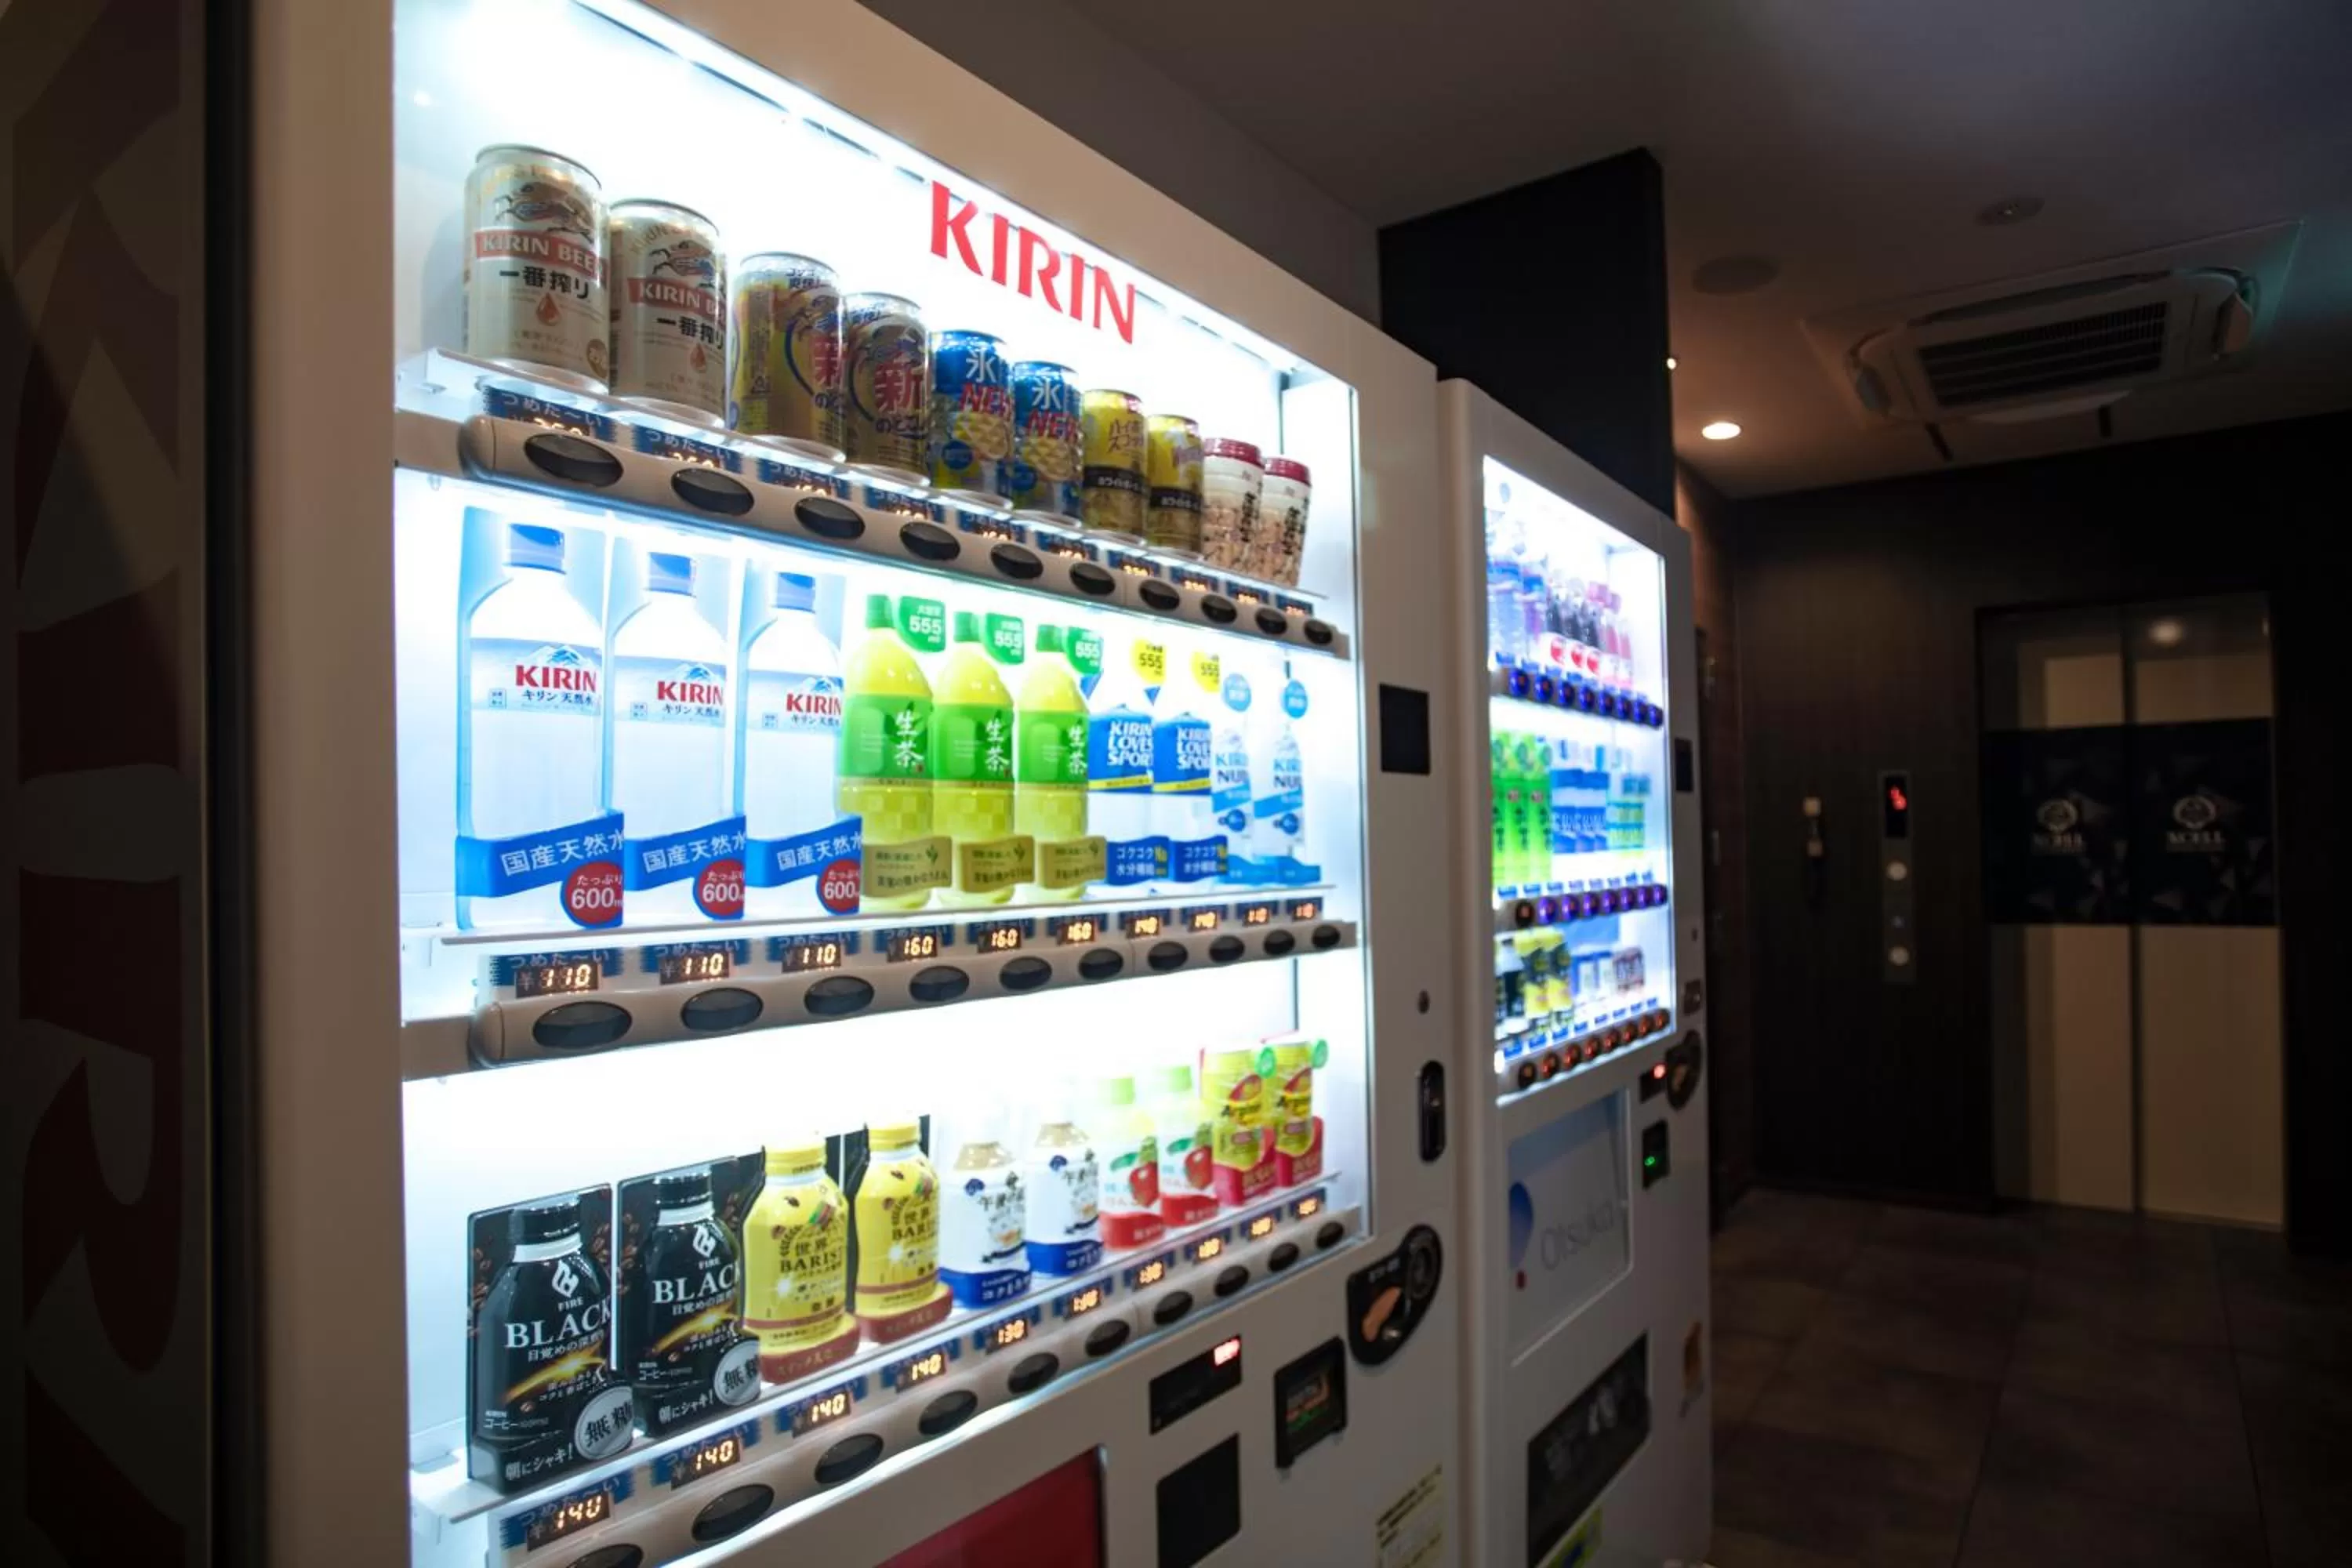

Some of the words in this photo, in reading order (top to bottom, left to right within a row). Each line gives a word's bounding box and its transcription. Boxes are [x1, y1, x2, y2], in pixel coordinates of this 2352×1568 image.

[483, 236, 549, 256] KIRIN
[931, 180, 1135, 345] KIRIN
[499, 266, 589, 299] 一番搾り
[640, 281, 700, 308] KIRIN
[909, 615, 942, 633] 555
[1139, 653, 1162, 670] 555
[515, 664, 597, 693] KIRIN
[658, 681, 724, 706] KIRIN
[786, 693, 841, 715] KIRIN
[895, 710, 924, 770] 生茶
[985, 717, 1011, 773] 生茶
[1069, 724, 1087, 775] 生茶
[500, 828, 624, 877] 国産天然水
[643, 829, 746, 873] 国産天然水
[576, 873, 623, 886] たっぷり
[903, 935, 933, 956] 160
[990, 928, 1018, 948] 160
[698, 1258, 720, 1270] FIRE
[557, 1297, 583, 1312] FIRE
[912, 1353, 942, 1381] 140
[811, 1392, 846, 1422] 140
[696, 1439, 733, 1472] 140
